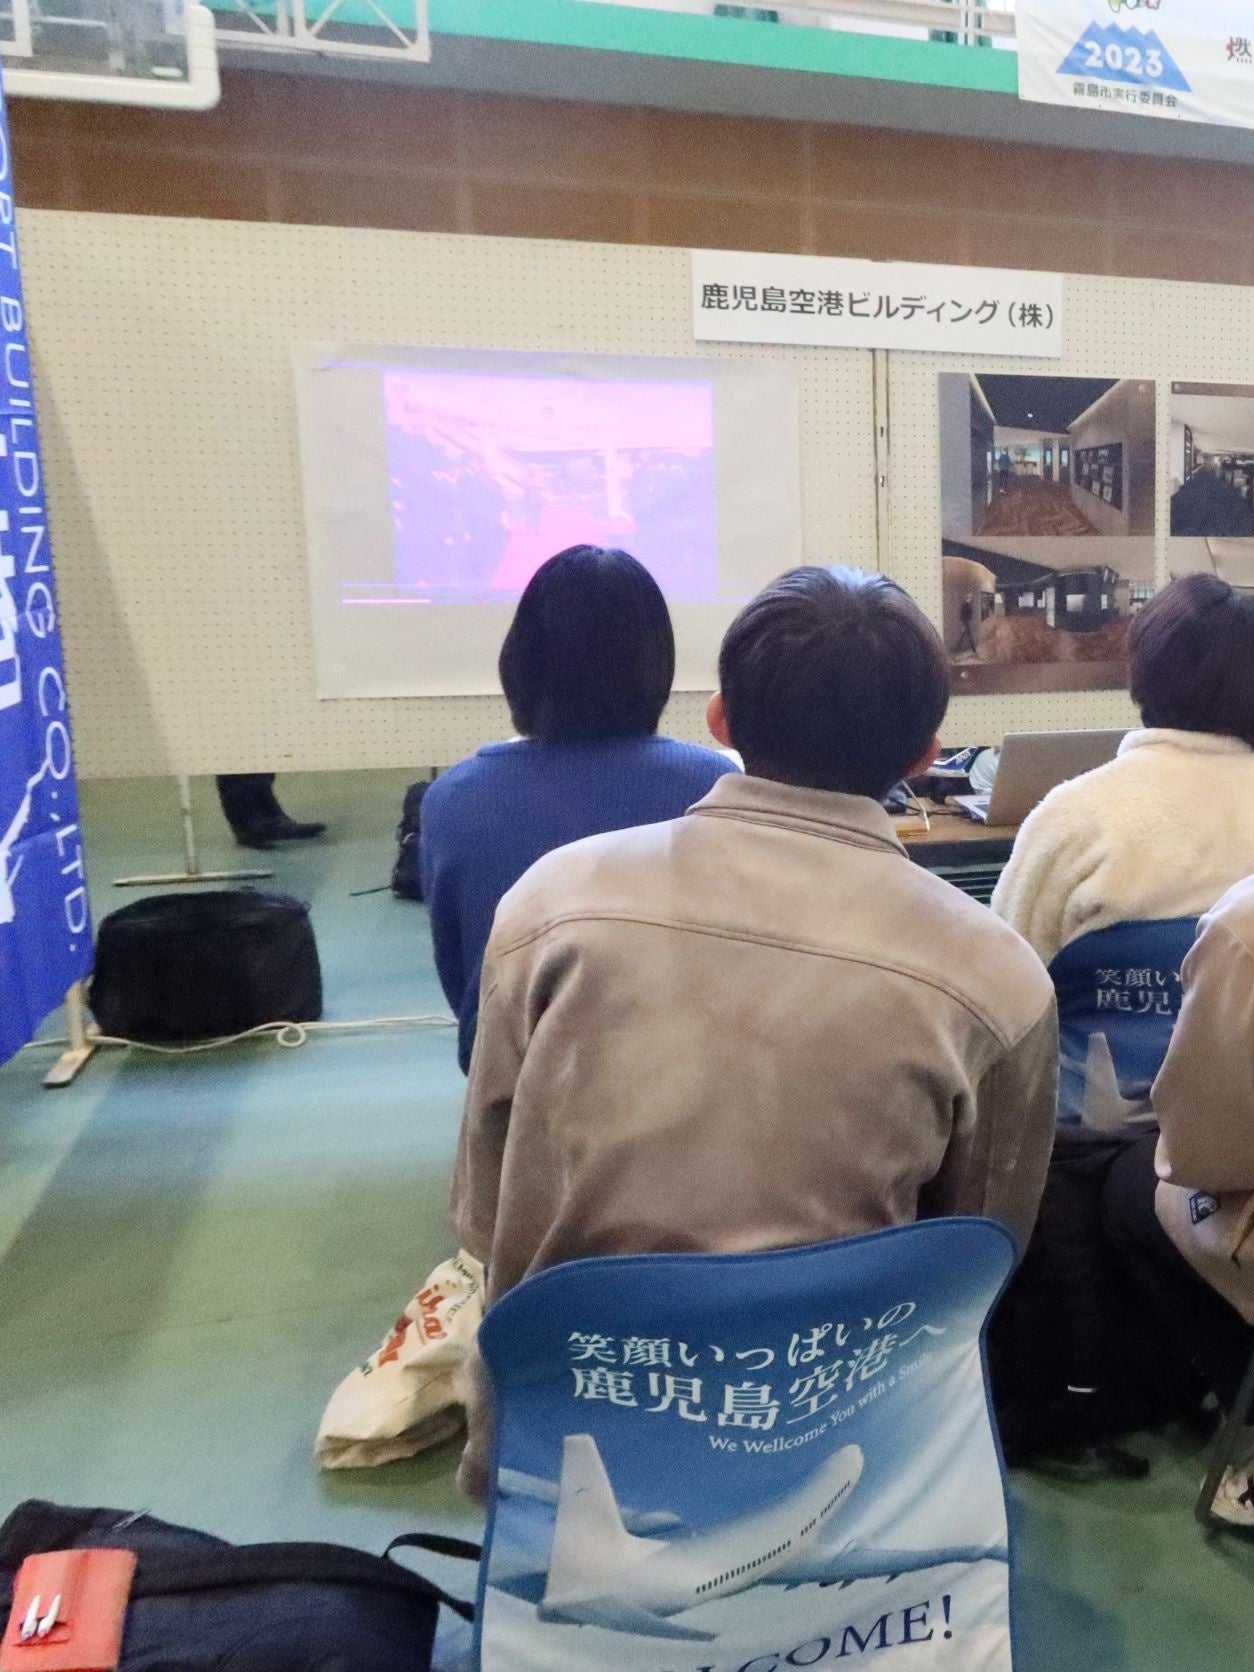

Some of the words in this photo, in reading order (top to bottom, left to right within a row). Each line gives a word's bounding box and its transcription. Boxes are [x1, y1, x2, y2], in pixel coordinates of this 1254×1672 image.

[1083, 40, 1164, 78] 2023
[701, 283, 1054, 330] 鹿児島空港ビルディング(株)
[1, 296, 55, 639] BUILDING
[566, 1301, 916, 1370] 笑顔いっぱいの
[570, 1322, 947, 1432] 鹿児島空港へ
[708, 1435, 738, 1453] We
[743, 1422, 828, 1454] Wellcome
[830, 1405, 855, 1427] You
[857, 1381, 886, 1409] with
